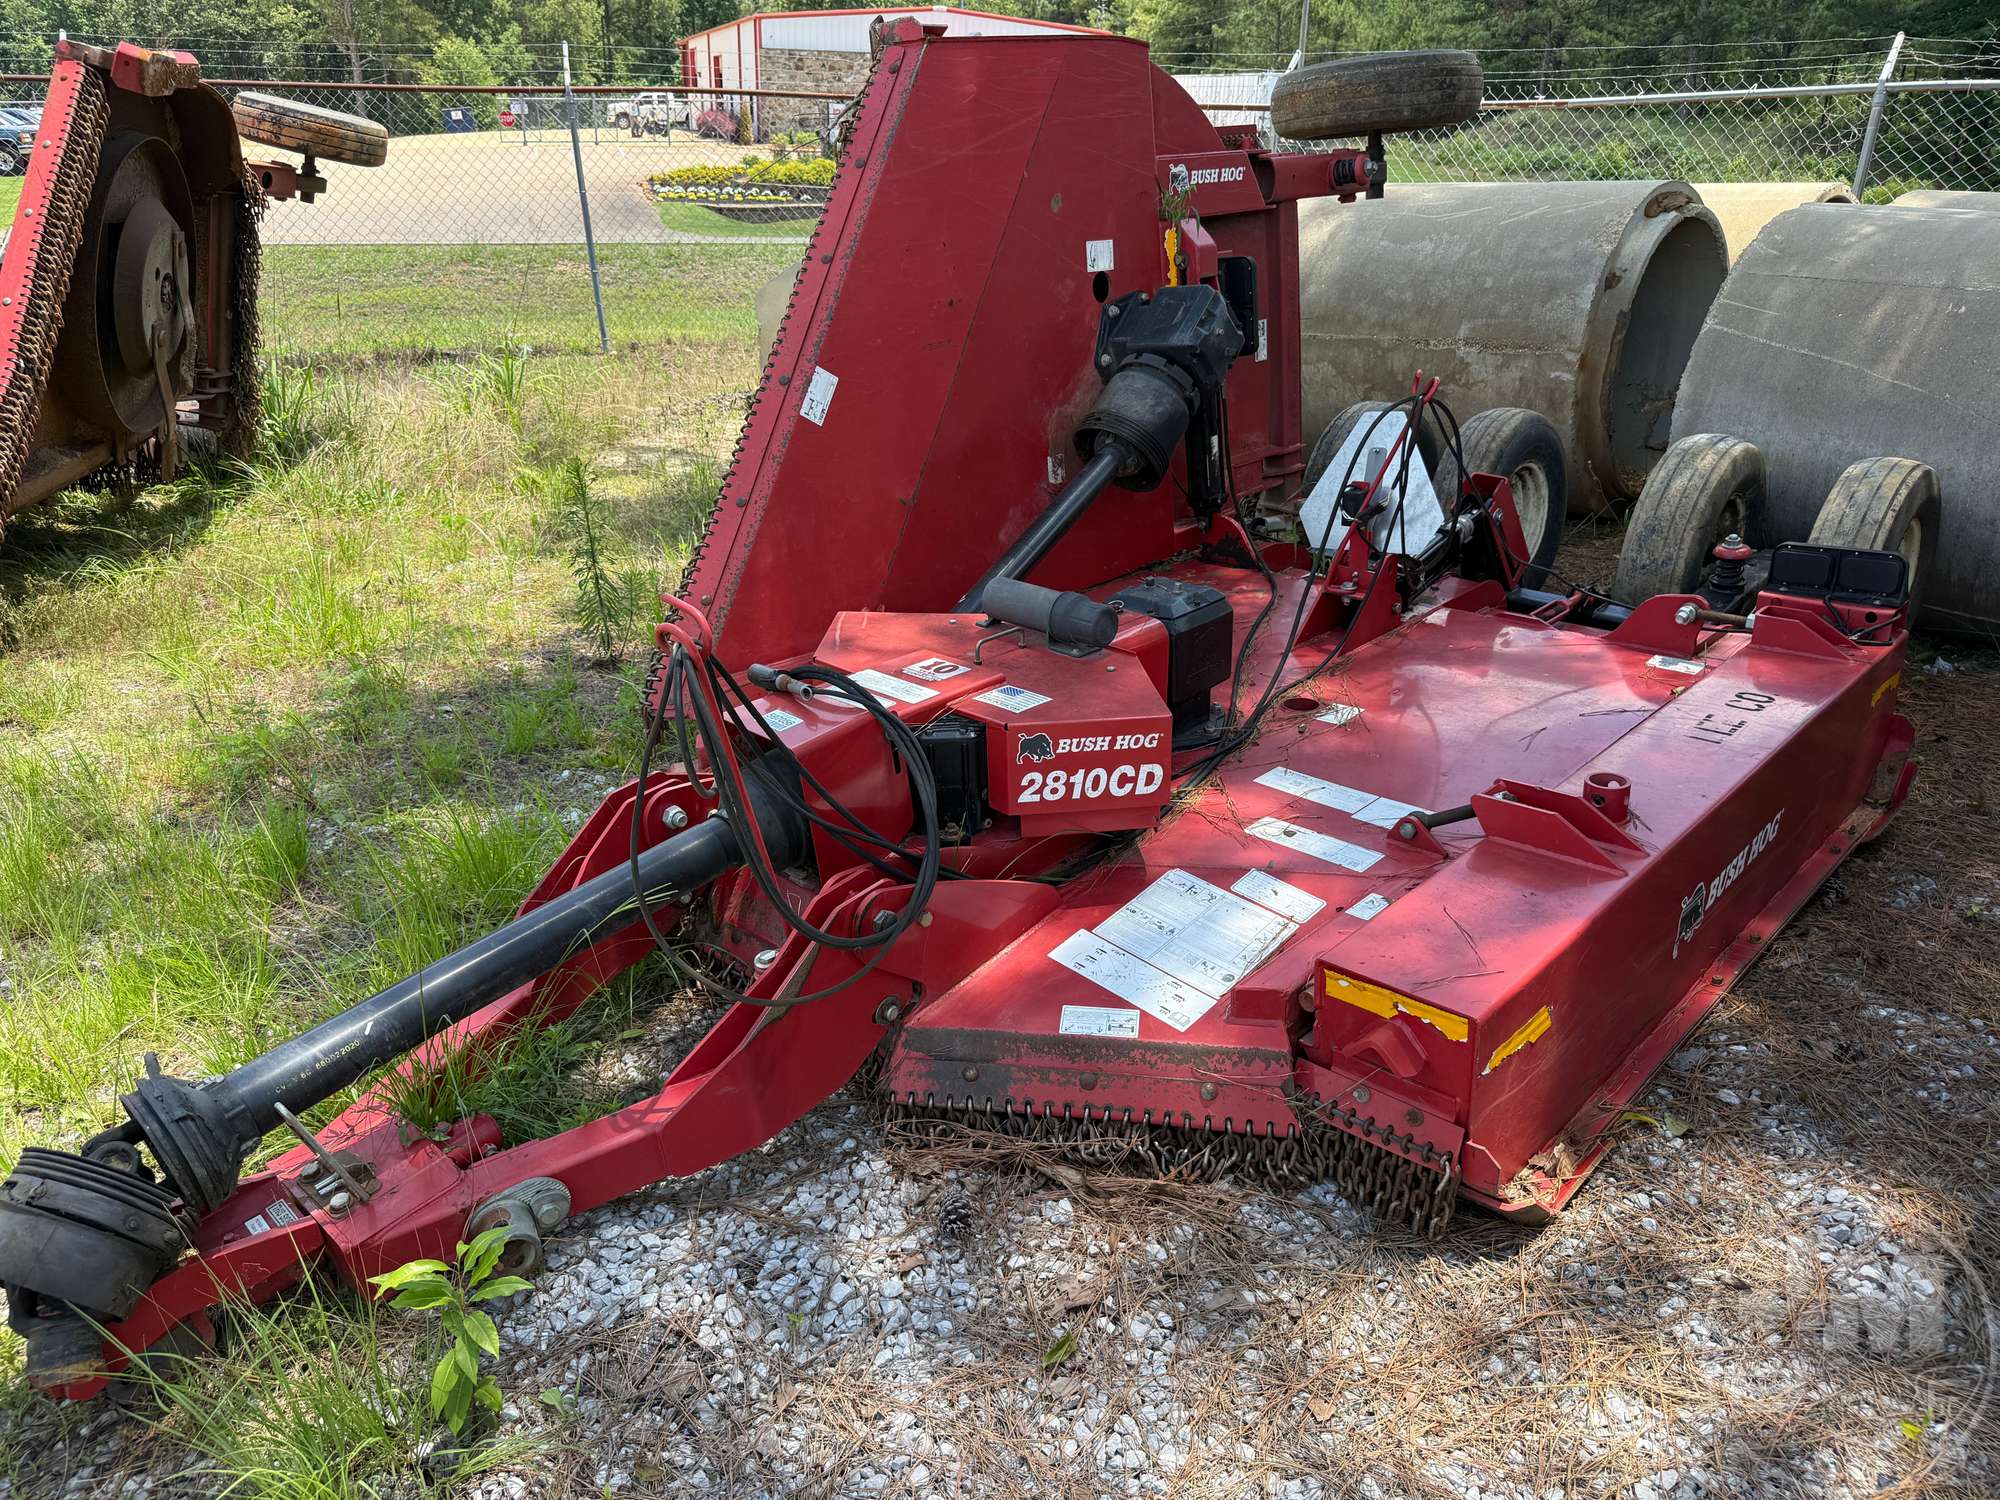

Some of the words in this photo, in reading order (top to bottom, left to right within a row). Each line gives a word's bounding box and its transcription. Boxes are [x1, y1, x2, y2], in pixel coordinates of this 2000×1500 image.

[1190, 168, 1220, 185] BUSH
[1220, 167, 1244, 182] HOG
[918, 660, 960, 674] 10
[1725, 691, 1776, 712] CO
[1056, 735, 1112, 754] BUSH
[1113, 733, 1160, 750] HOG
[1017, 763, 1164, 803] 2810CD
[1704, 844, 1750, 911] BUSH
[1747, 813, 1782, 866] HOG
